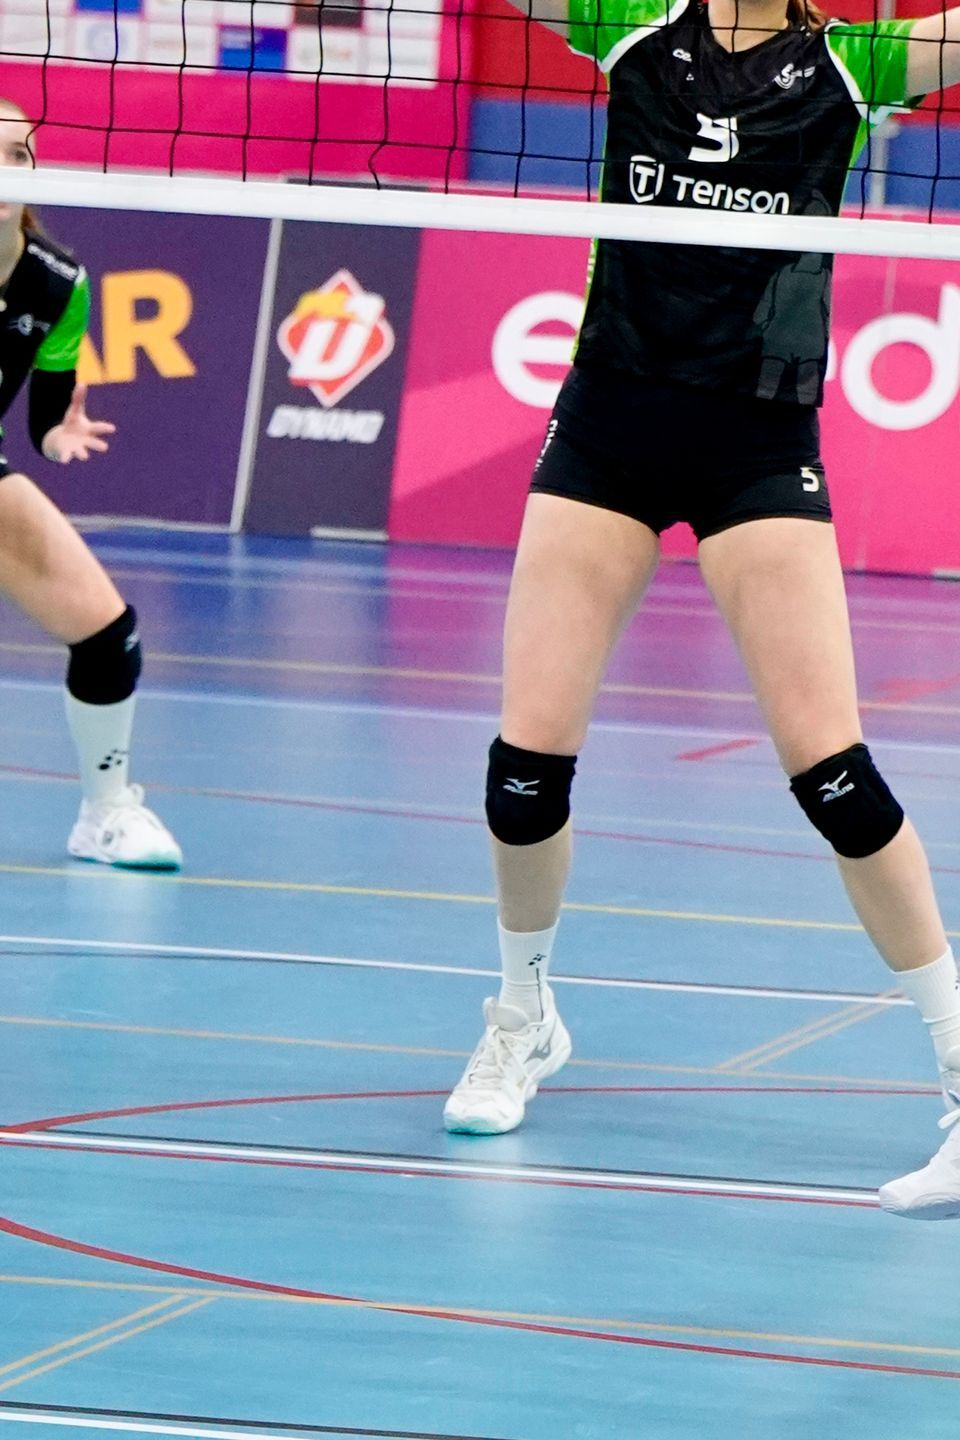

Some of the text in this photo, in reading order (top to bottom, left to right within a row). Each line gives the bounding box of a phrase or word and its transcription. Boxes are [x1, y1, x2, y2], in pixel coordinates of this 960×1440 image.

[688, 113, 739, 162] 5
[672, 174, 790, 216] Tenson
[801, 466, 820, 493] 5
